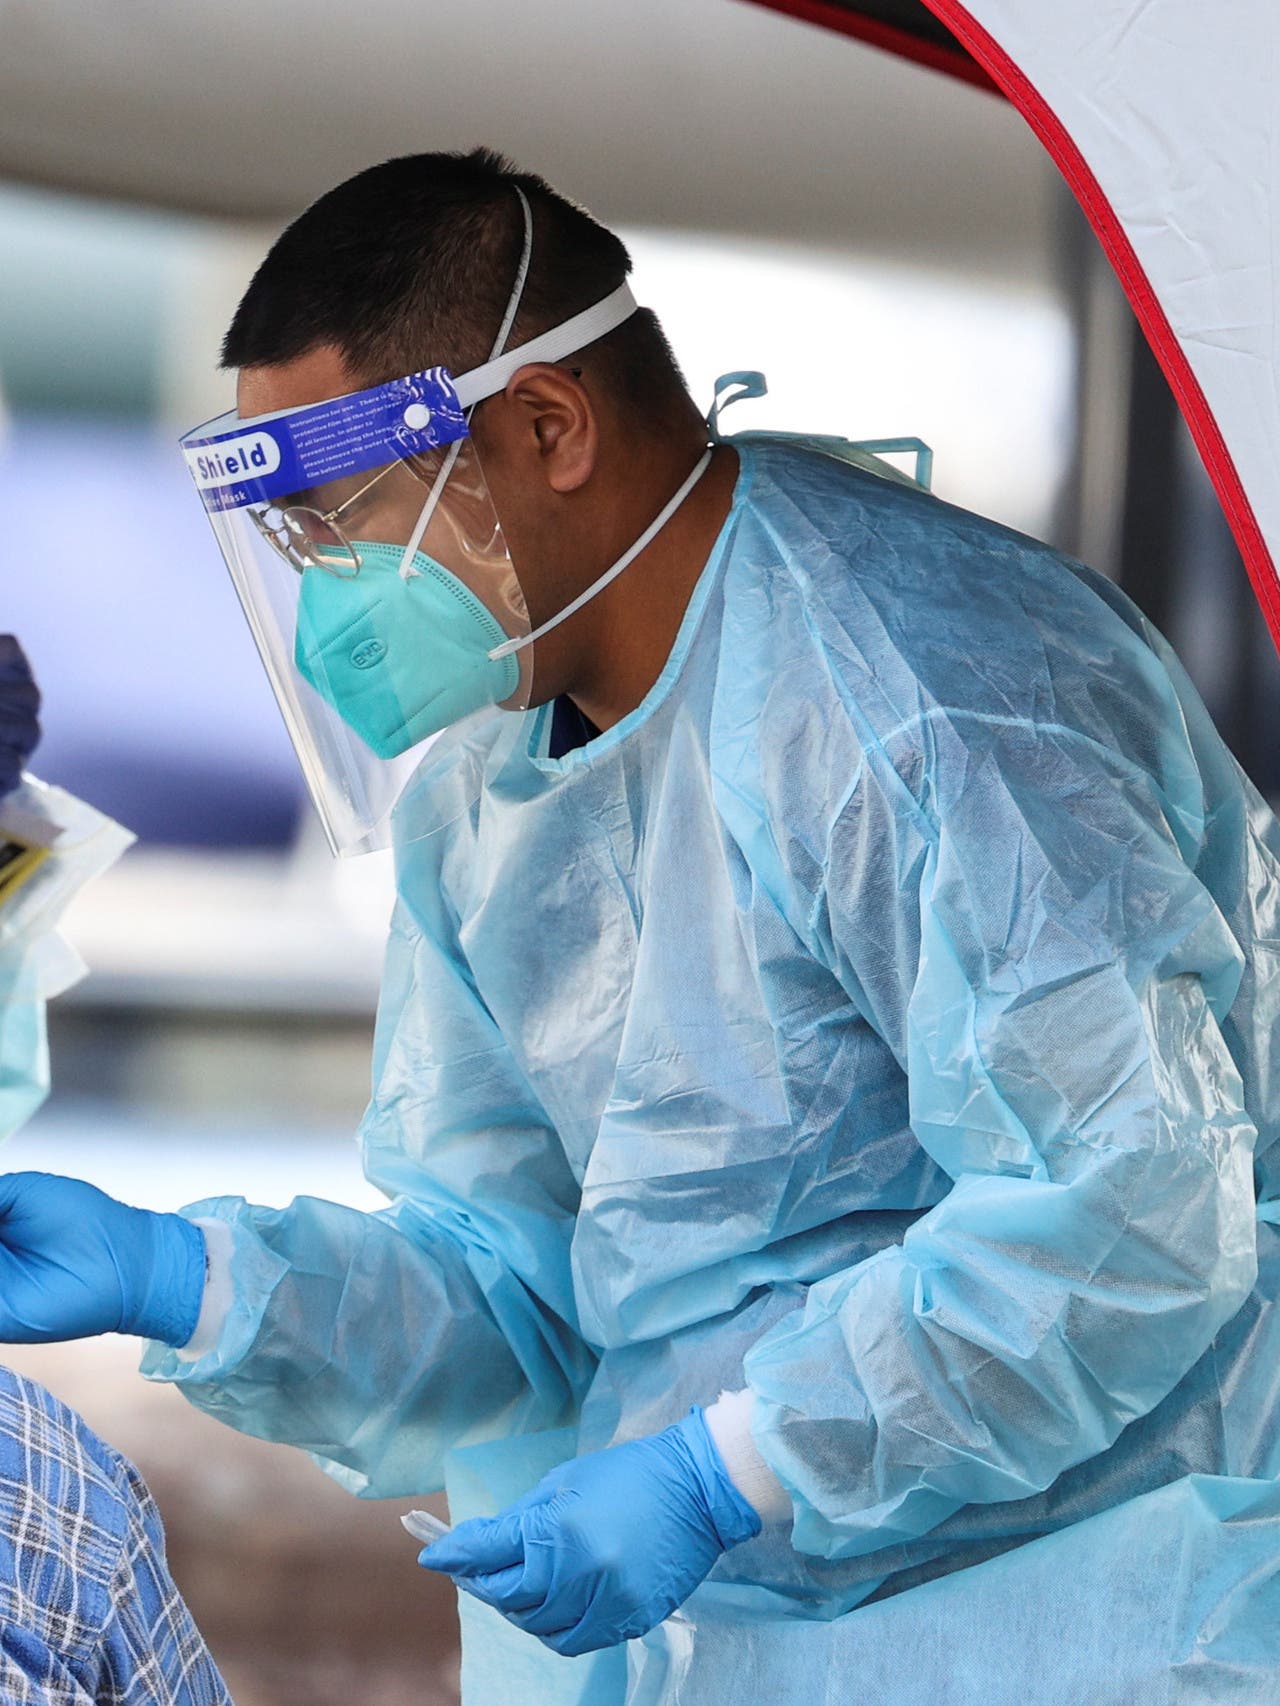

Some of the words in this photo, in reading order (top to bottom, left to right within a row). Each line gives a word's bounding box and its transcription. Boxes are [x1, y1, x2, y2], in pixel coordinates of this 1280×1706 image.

[360, 396, 380, 407] There
[293, 424, 327, 440] protective
[327, 419, 342, 428] film
[352, 412, 364, 420] the
[365, 407, 384, 416] outer
[304, 438, 313, 447] all
[346, 424, 365, 434] order
[300, 447, 325, 460] prevent
[326, 436, 362, 450] scratching
[362, 431, 374, 439] the
[303, 457, 325, 470] please
[325, 450, 351, 462] remove
[351, 445, 363, 454] the
[364, 440, 383, 450] outer
[197, 442, 267, 480] Shield
[306, 471, 320, 479] film
[321, 464, 342, 475] before
